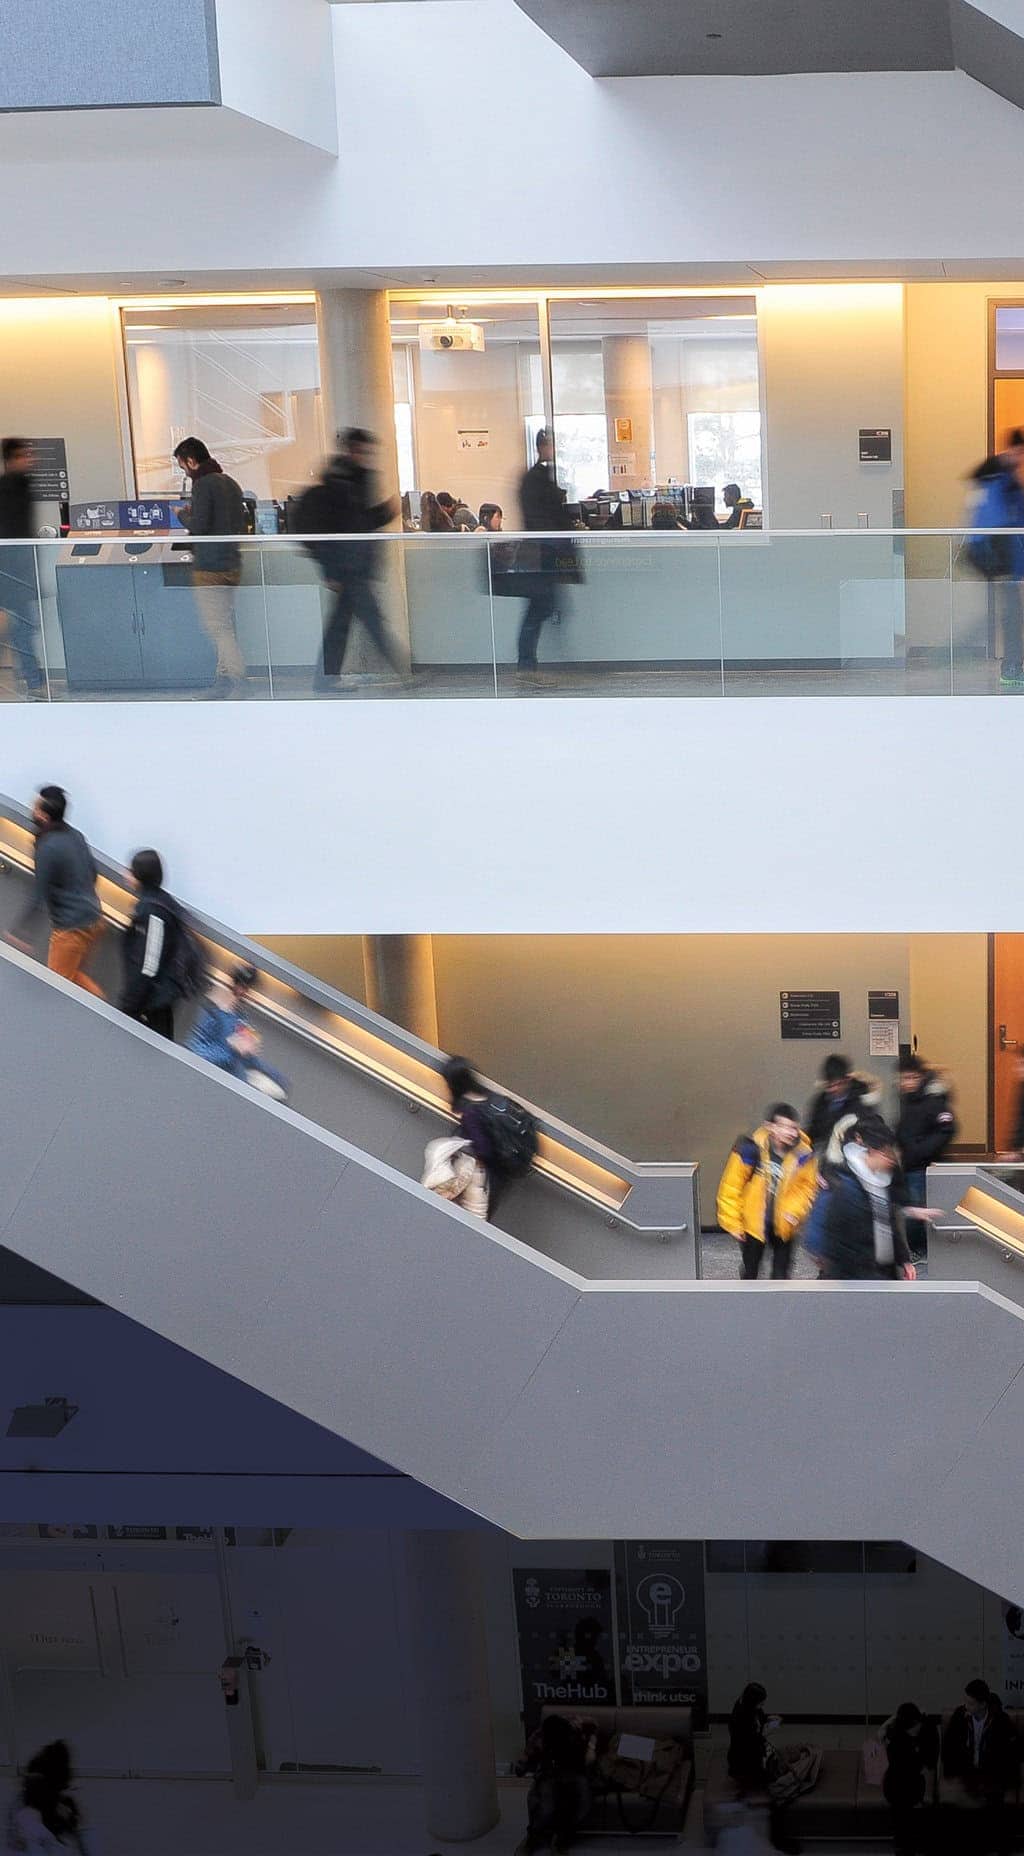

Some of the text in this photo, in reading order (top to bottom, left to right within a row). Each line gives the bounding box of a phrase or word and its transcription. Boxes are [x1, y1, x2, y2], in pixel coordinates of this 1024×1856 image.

[543, 1592, 602, 1601] TORONTO
[625, 1646, 698, 1654] ENTREPRENEUR
[624, 1653, 701, 1679] expo
[531, 1682, 608, 1698] TheHub
[632, 1687, 697, 1703] think utsc
